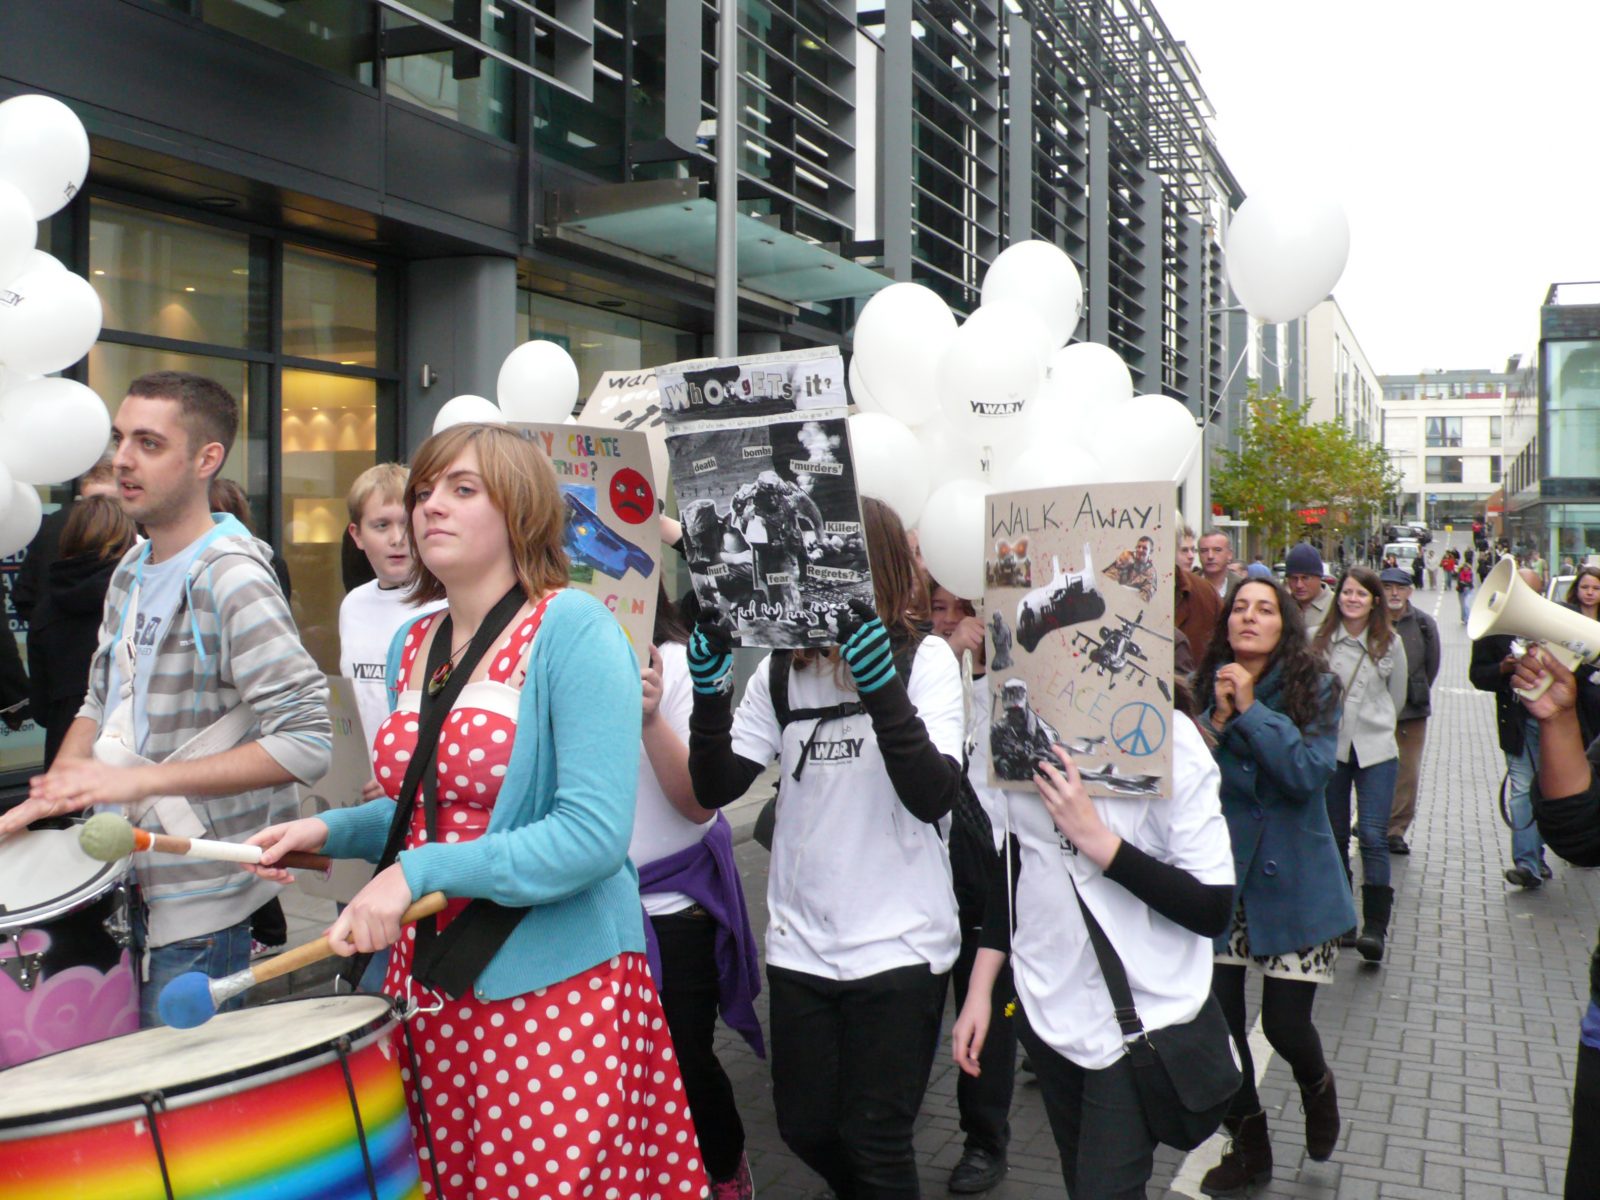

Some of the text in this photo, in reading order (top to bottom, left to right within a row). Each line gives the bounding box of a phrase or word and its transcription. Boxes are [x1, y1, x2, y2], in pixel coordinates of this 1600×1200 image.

[805, 373, 832, 397] it?
[567, 433, 621, 457] CREATE
[743, 447, 772, 458] bombs
[553, 459, 598, 481] THIS?
[694, 458, 717, 473] death
[992, 501, 1060, 538] WALK
[827, 521, 860, 534] Killed
[707, 565, 728, 576] hurt
[806, 566, 855, 581] Regrets?
[769, 574, 789, 584] fear
[604, 593, 645, 616] CAN
